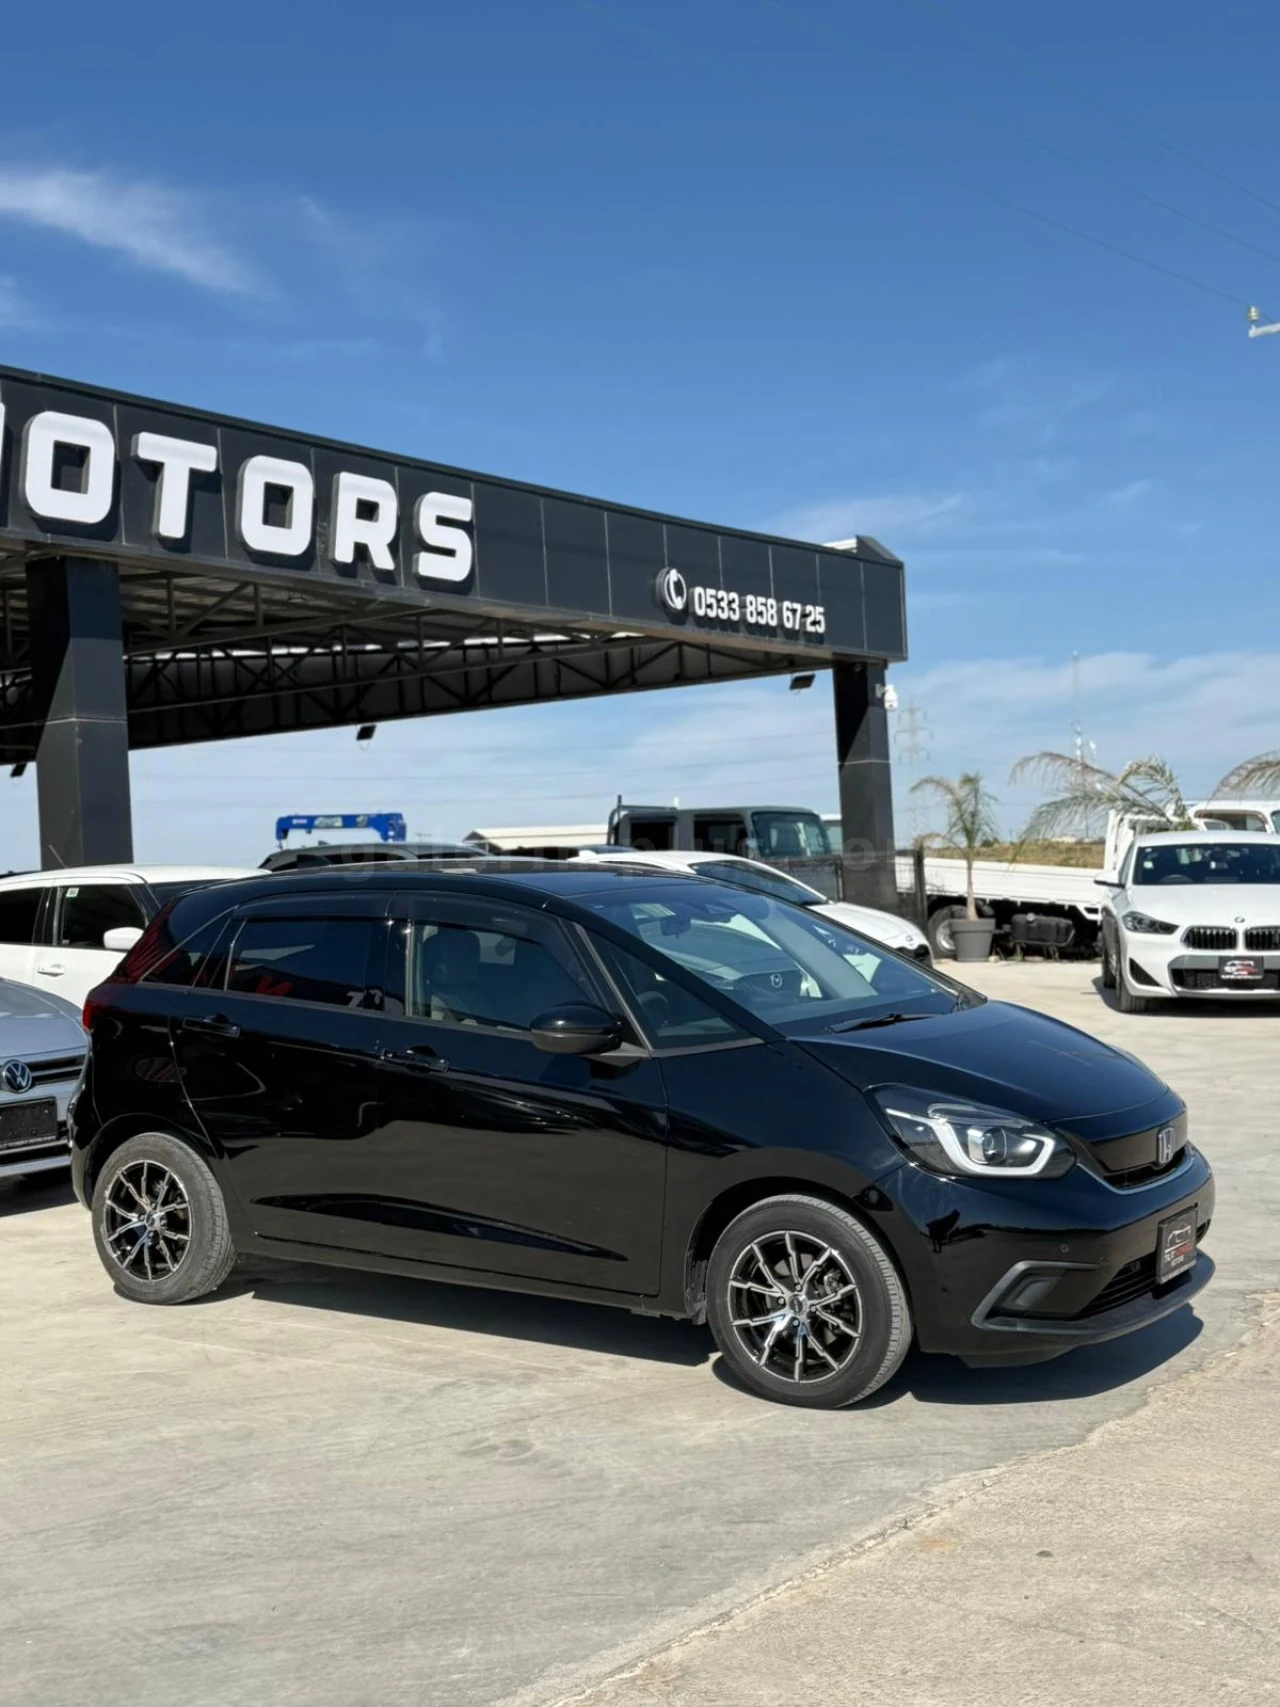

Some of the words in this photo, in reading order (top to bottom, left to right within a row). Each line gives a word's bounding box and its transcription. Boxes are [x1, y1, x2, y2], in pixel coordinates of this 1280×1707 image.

[0, 402, 473, 582] OTORS
[693, 586, 740, 621] 0533
[745, 594, 778, 627] 858
[782, 600, 802, 631] 67
[805, 604, 826, 634] 25
